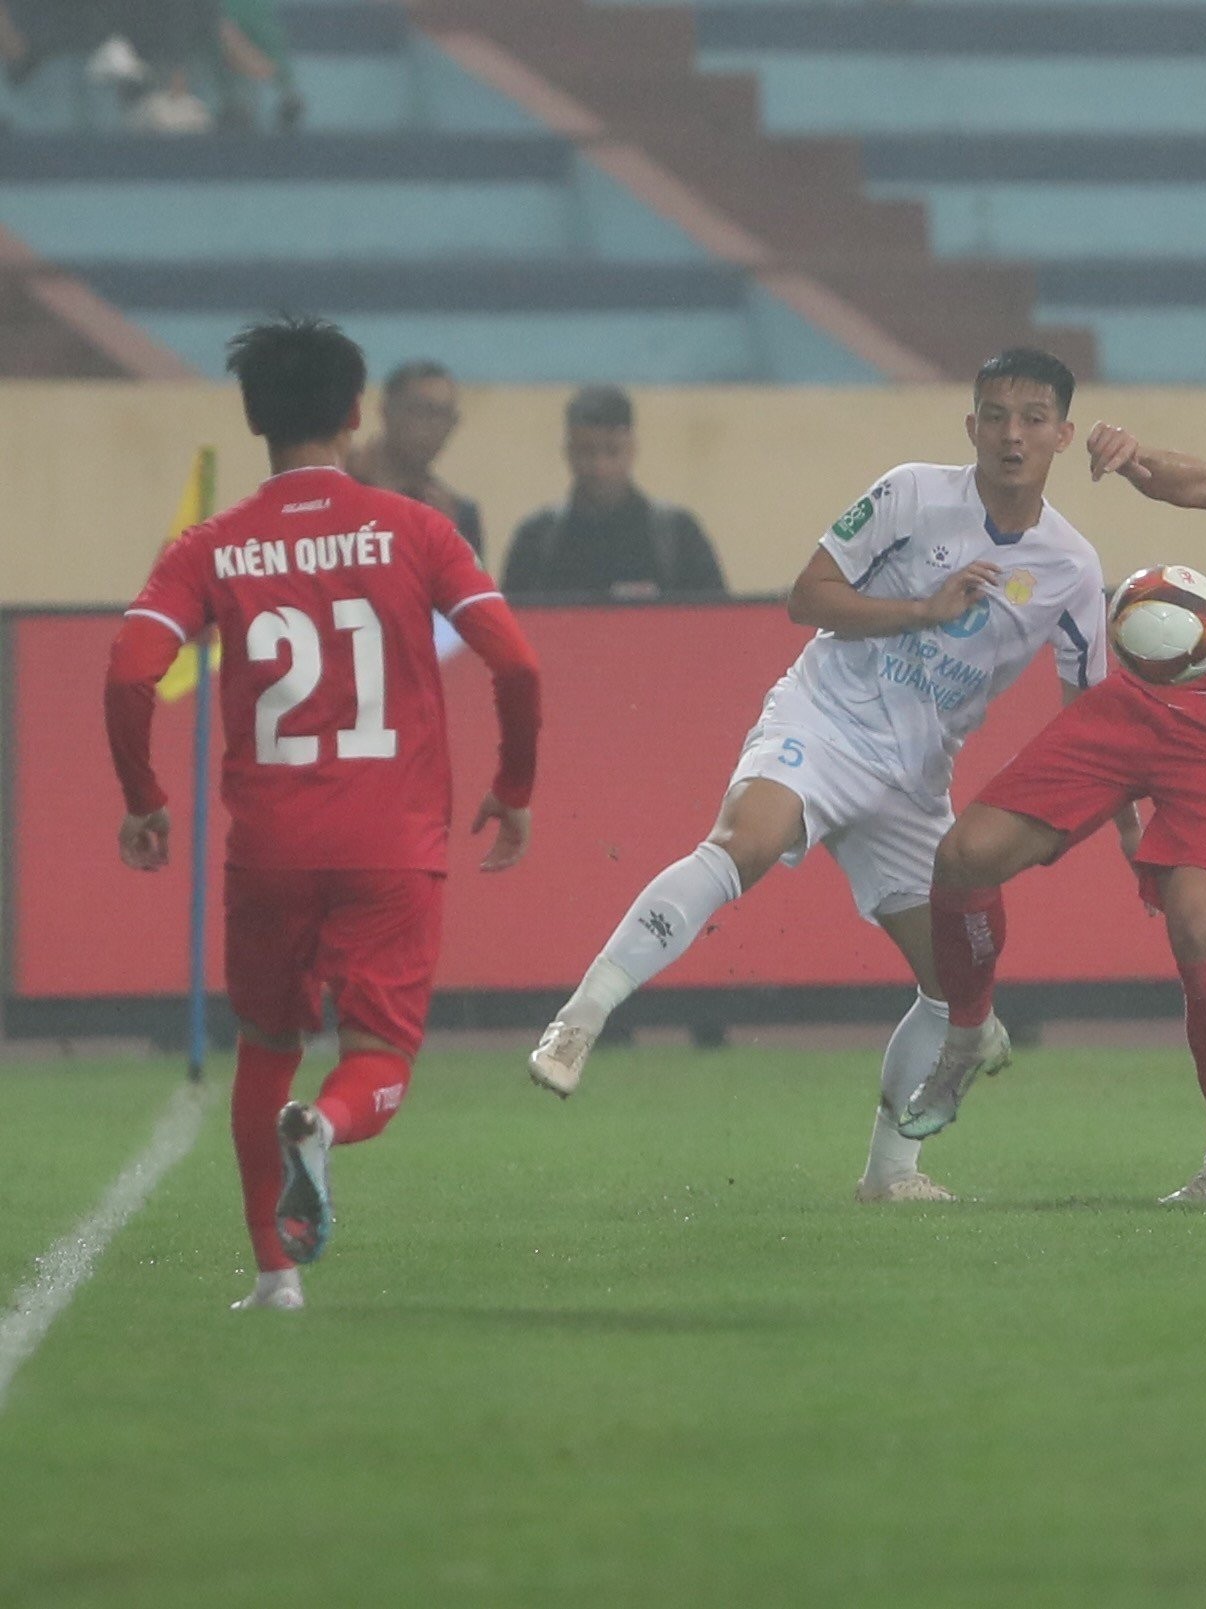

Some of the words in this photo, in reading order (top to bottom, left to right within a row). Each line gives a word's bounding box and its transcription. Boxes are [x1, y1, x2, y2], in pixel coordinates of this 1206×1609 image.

[214, 538, 288, 579] KIÊN
[295, 520, 393, 574] QUYẾT
[247, 598, 398, 766] 21
[778, 738, 806, 769] 5
